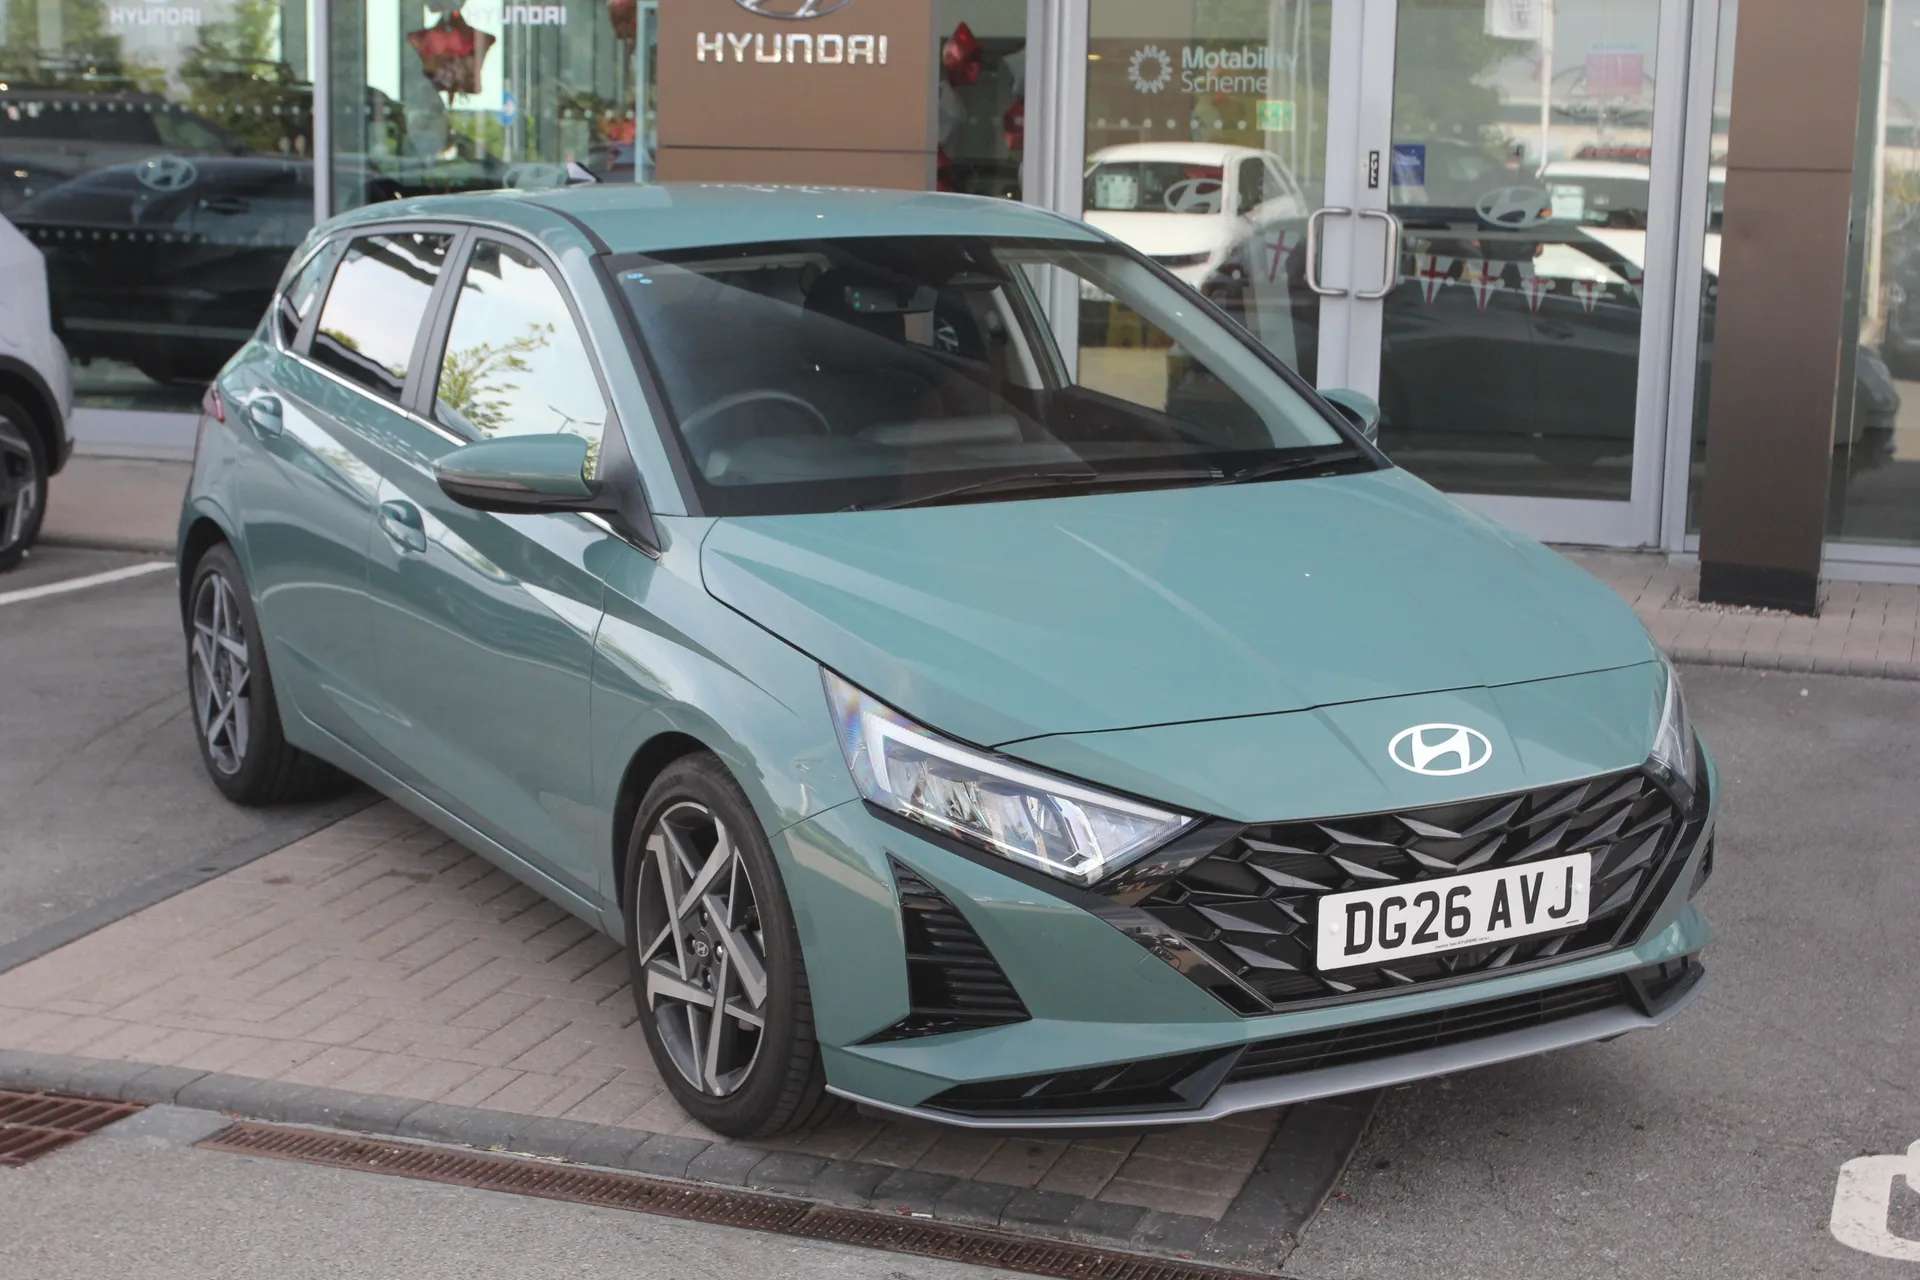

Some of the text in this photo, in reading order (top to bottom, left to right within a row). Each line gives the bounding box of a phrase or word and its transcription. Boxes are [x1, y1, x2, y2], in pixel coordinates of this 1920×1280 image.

[111, 7, 202, 26] HYUNDAI
[696, 31, 888, 64] HYUNDAI
[1181, 46, 1298, 72] Motability
[1181, 70, 1268, 93] Scheme
[1344, 866, 1574, 956] DG26 AVJ
